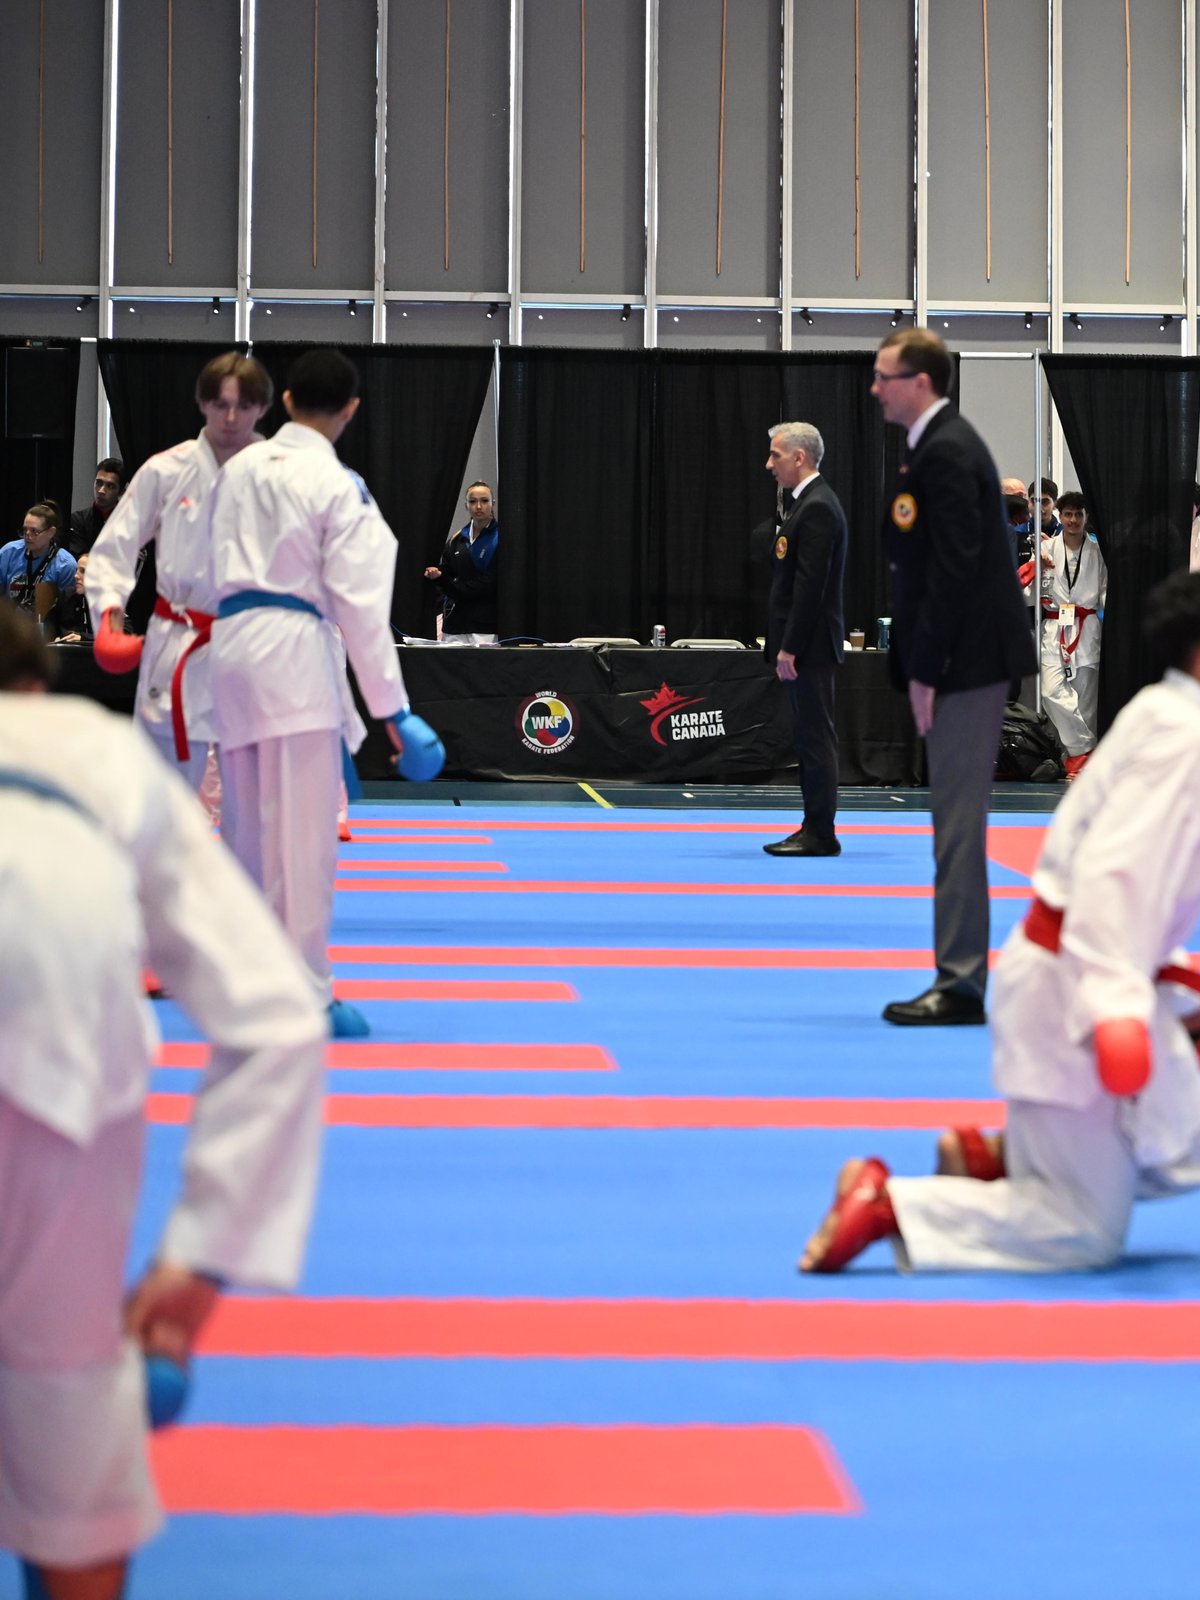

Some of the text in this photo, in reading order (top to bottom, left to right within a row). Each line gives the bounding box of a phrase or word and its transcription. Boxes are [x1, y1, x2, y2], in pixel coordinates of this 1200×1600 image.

[535, 690, 557, 698] WORLD
[531, 715, 562, 730] WKF
[671, 710, 723, 728] KARATE
[672, 723, 726, 741] CANADA
[521, 735, 576, 755] KARATE FEDERATION
